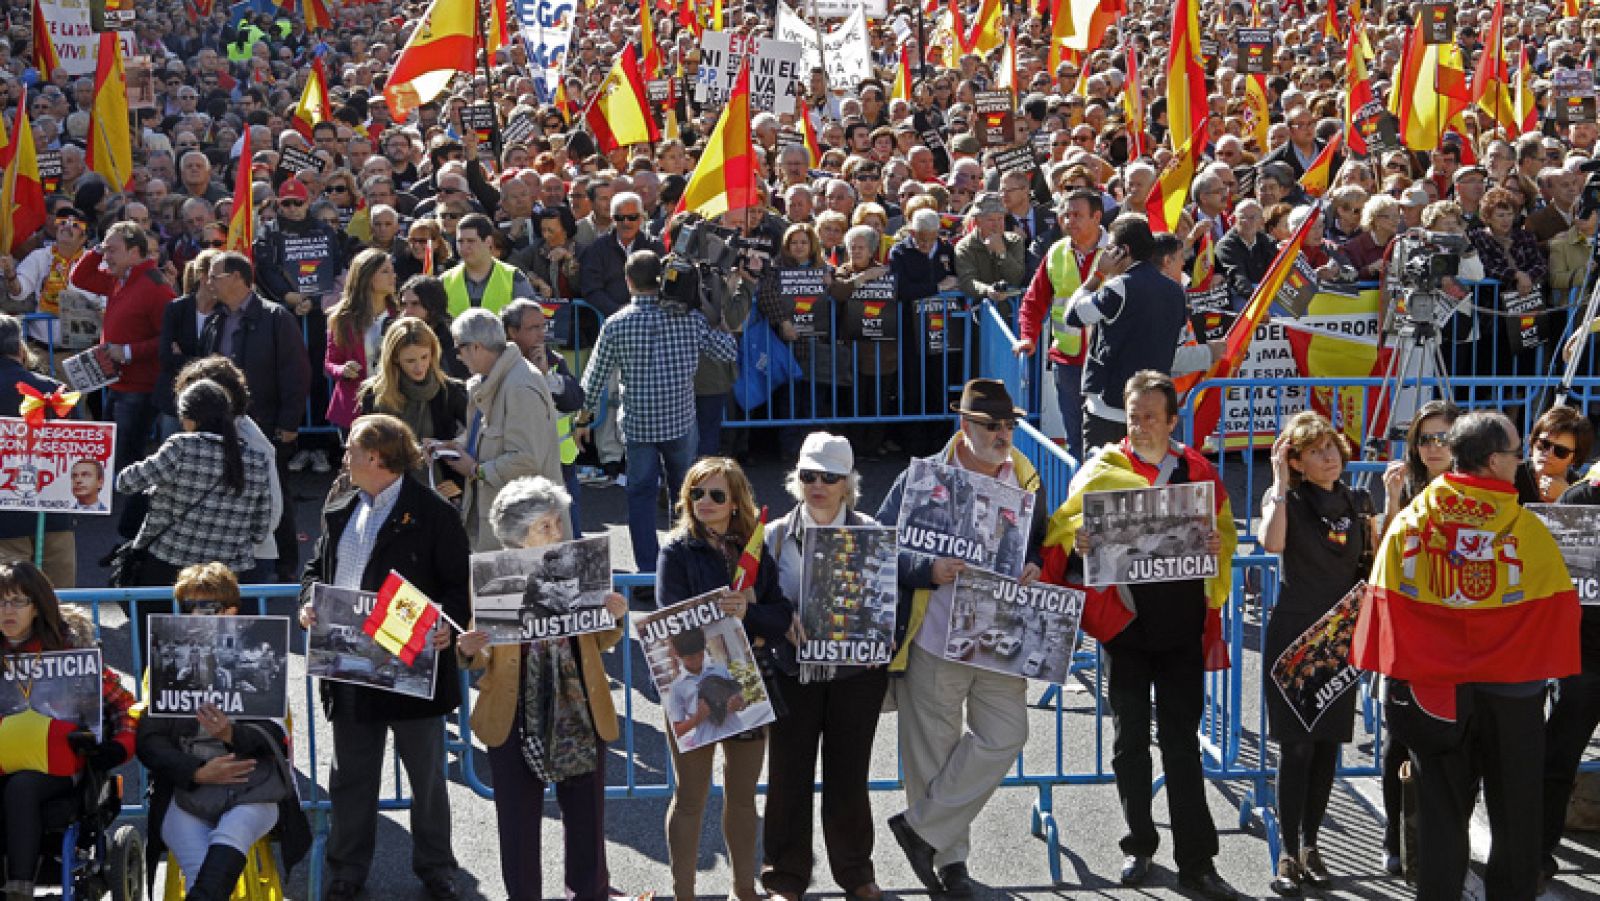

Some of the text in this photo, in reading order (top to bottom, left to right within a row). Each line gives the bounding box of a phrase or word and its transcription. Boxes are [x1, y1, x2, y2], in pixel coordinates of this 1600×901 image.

[700, 49, 721, 67] NI
[760, 58, 775, 76] NI
[778, 60, 799, 79] EL
[754, 75, 775, 95] VA
[781, 285, 824, 295] JUSTICIA
[793, 314, 814, 322] VCT
[862, 318, 883, 328] VCT
[1, 423, 28, 437] NO
[32, 441, 105, 455] ASESINOS
[900, 526, 982, 562] JUSTICIA
[1128, 555, 1214, 579] JUSTICIA
[993, 580, 1077, 616] JUSTICIA
[523, 608, 611, 639] JUSTICIA
[643, 600, 725, 643] JUSTICI
[801, 640, 886, 661] JUSTICIA
[4, 655, 98, 681] JUSTICIA
[156, 689, 245, 713] JUSTICIA
